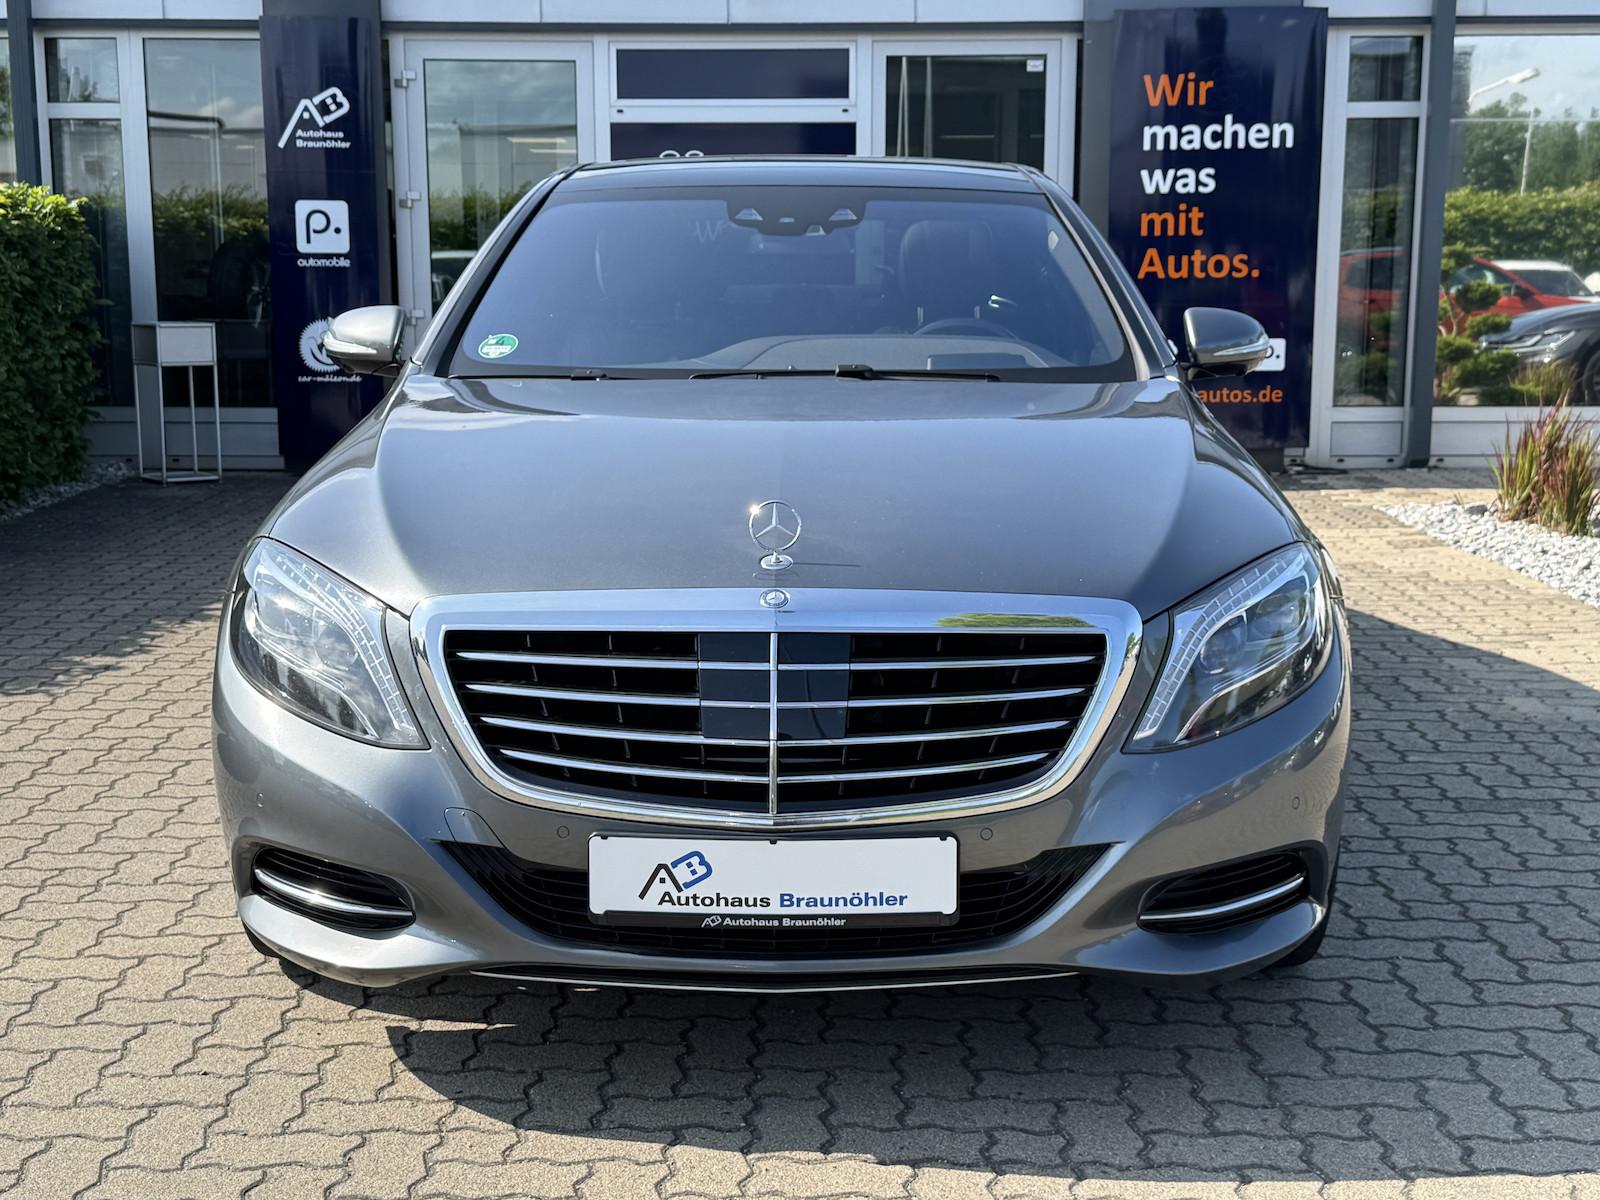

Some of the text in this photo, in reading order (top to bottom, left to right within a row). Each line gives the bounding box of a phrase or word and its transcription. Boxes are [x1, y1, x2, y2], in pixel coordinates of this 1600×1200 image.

[1143, 72, 1214, 107] Wir
[295, 129, 344, 138] Autohaus
[1142, 113, 1295, 151] machen
[295, 139, 351, 149] Braunöhler
[1140, 167, 1217, 195] was
[1140, 203, 1204, 237] mit
[297, 256, 351, 268] automobile
[1137, 247, 1260, 279] Autos.
[658, 891, 908, 908] Autohaus Braunöhler
[723, 917, 779, 927] Autohaus
[782, 917, 847, 927] Braunöhler
